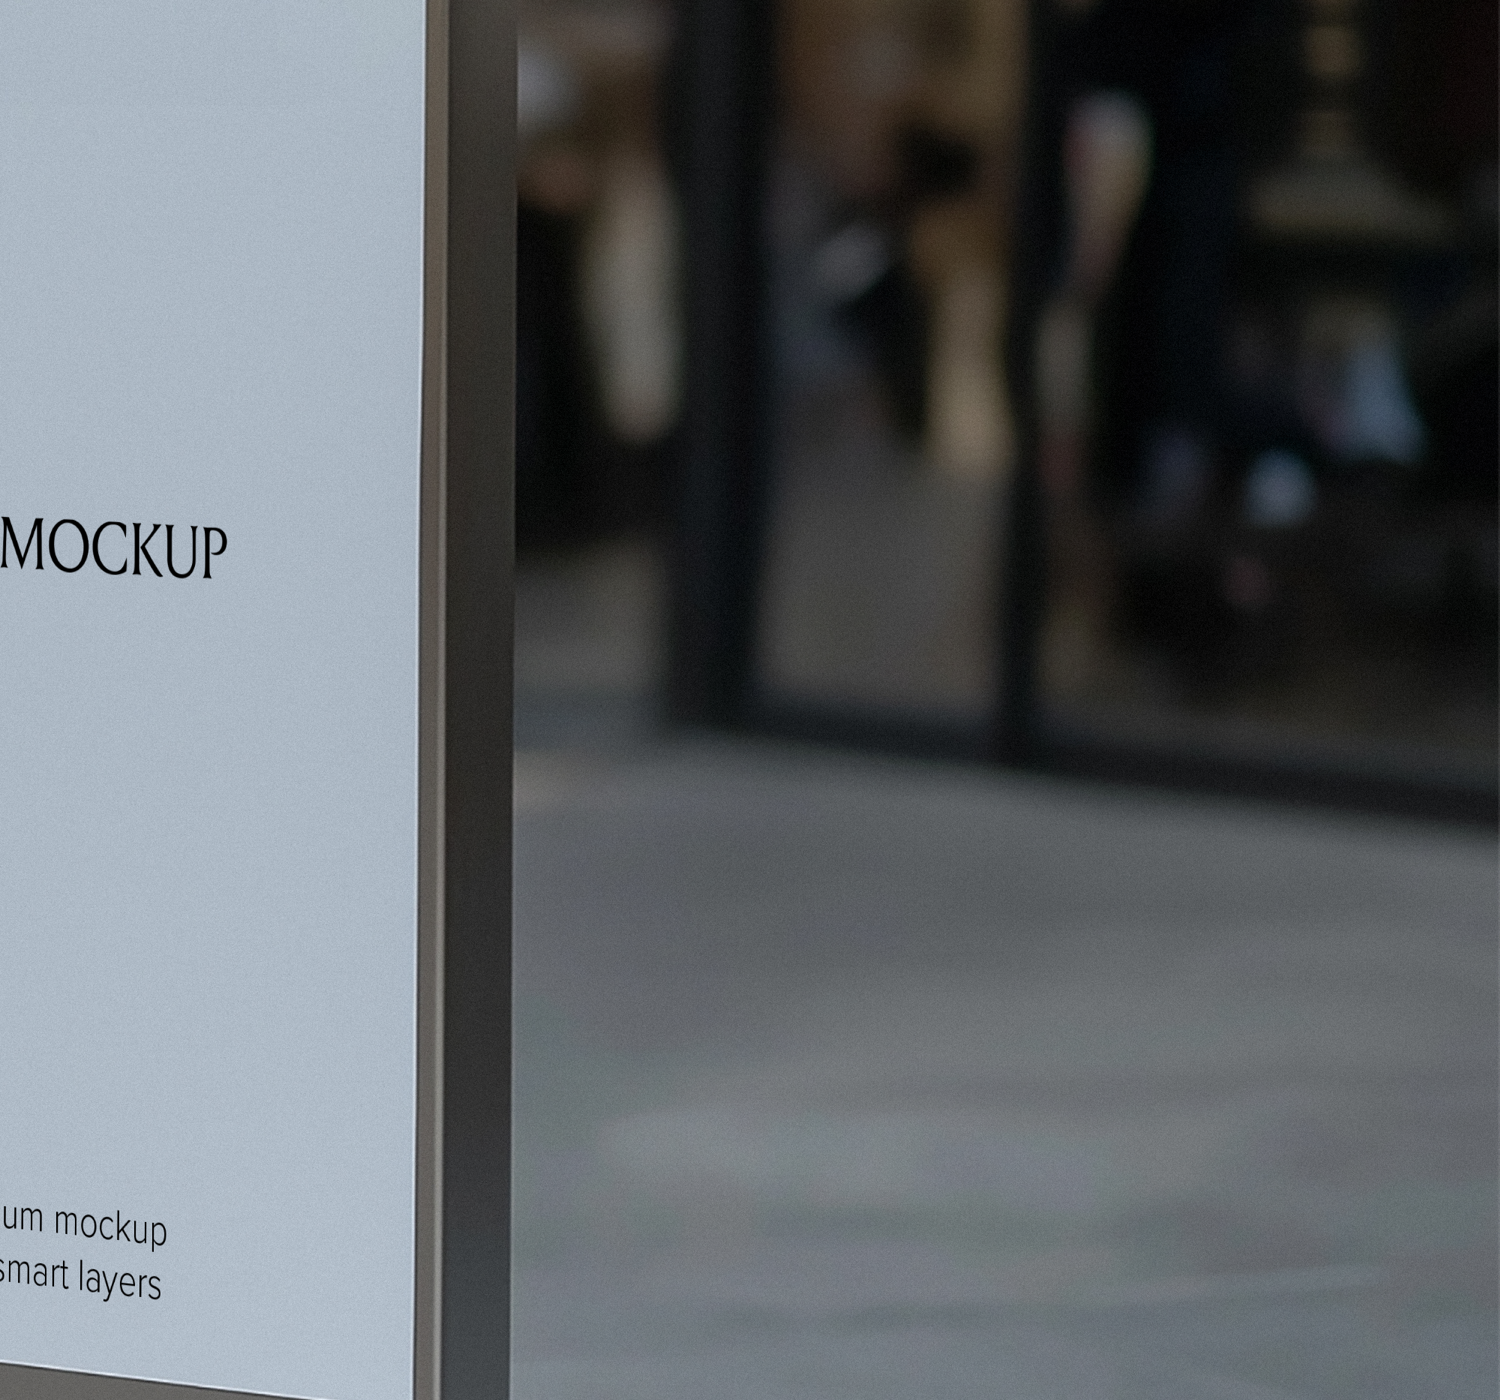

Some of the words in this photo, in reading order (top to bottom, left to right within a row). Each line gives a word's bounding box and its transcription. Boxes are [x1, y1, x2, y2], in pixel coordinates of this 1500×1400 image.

[0, 515, 229, 580] MOCKUP
[55, 1210, 167, 1252] mockup
[79, 1259, 162, 1302] layers
